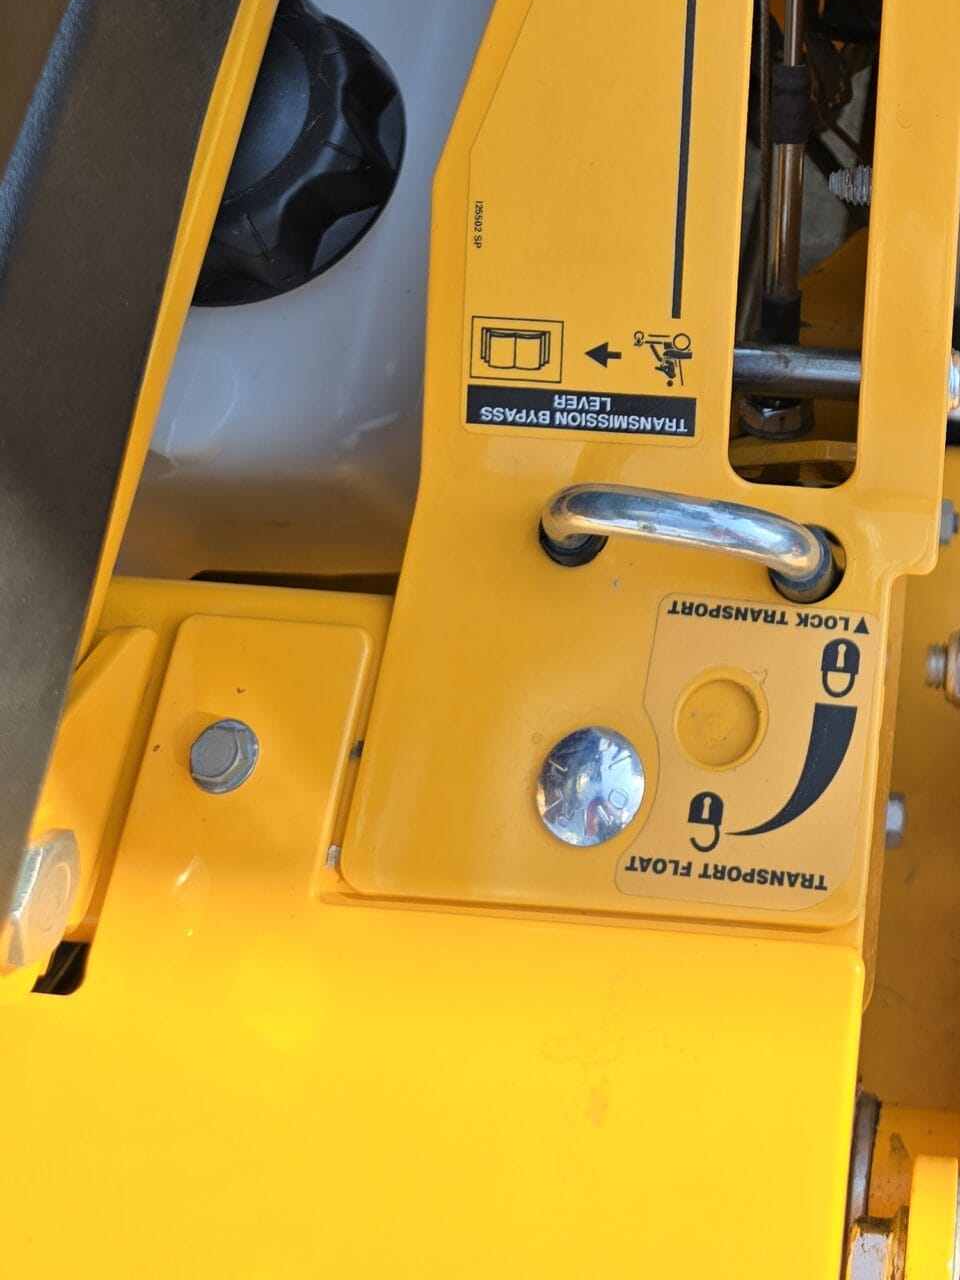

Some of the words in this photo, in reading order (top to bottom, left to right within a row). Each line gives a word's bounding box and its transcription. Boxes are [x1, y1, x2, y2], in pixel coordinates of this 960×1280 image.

[474, 235, 483, 248] SP
[553, 394, 611, 412] LEVER
[480, 406, 550, 424] BYPASS
[555, 411, 688, 432] TRANSMISSION
[667, 600, 788, 625] TRANSPORT
[795, 612, 849, 631] LOCK
[624, 856, 693, 877] FLOAT
[698, 863, 827, 891] TRANSPORT
